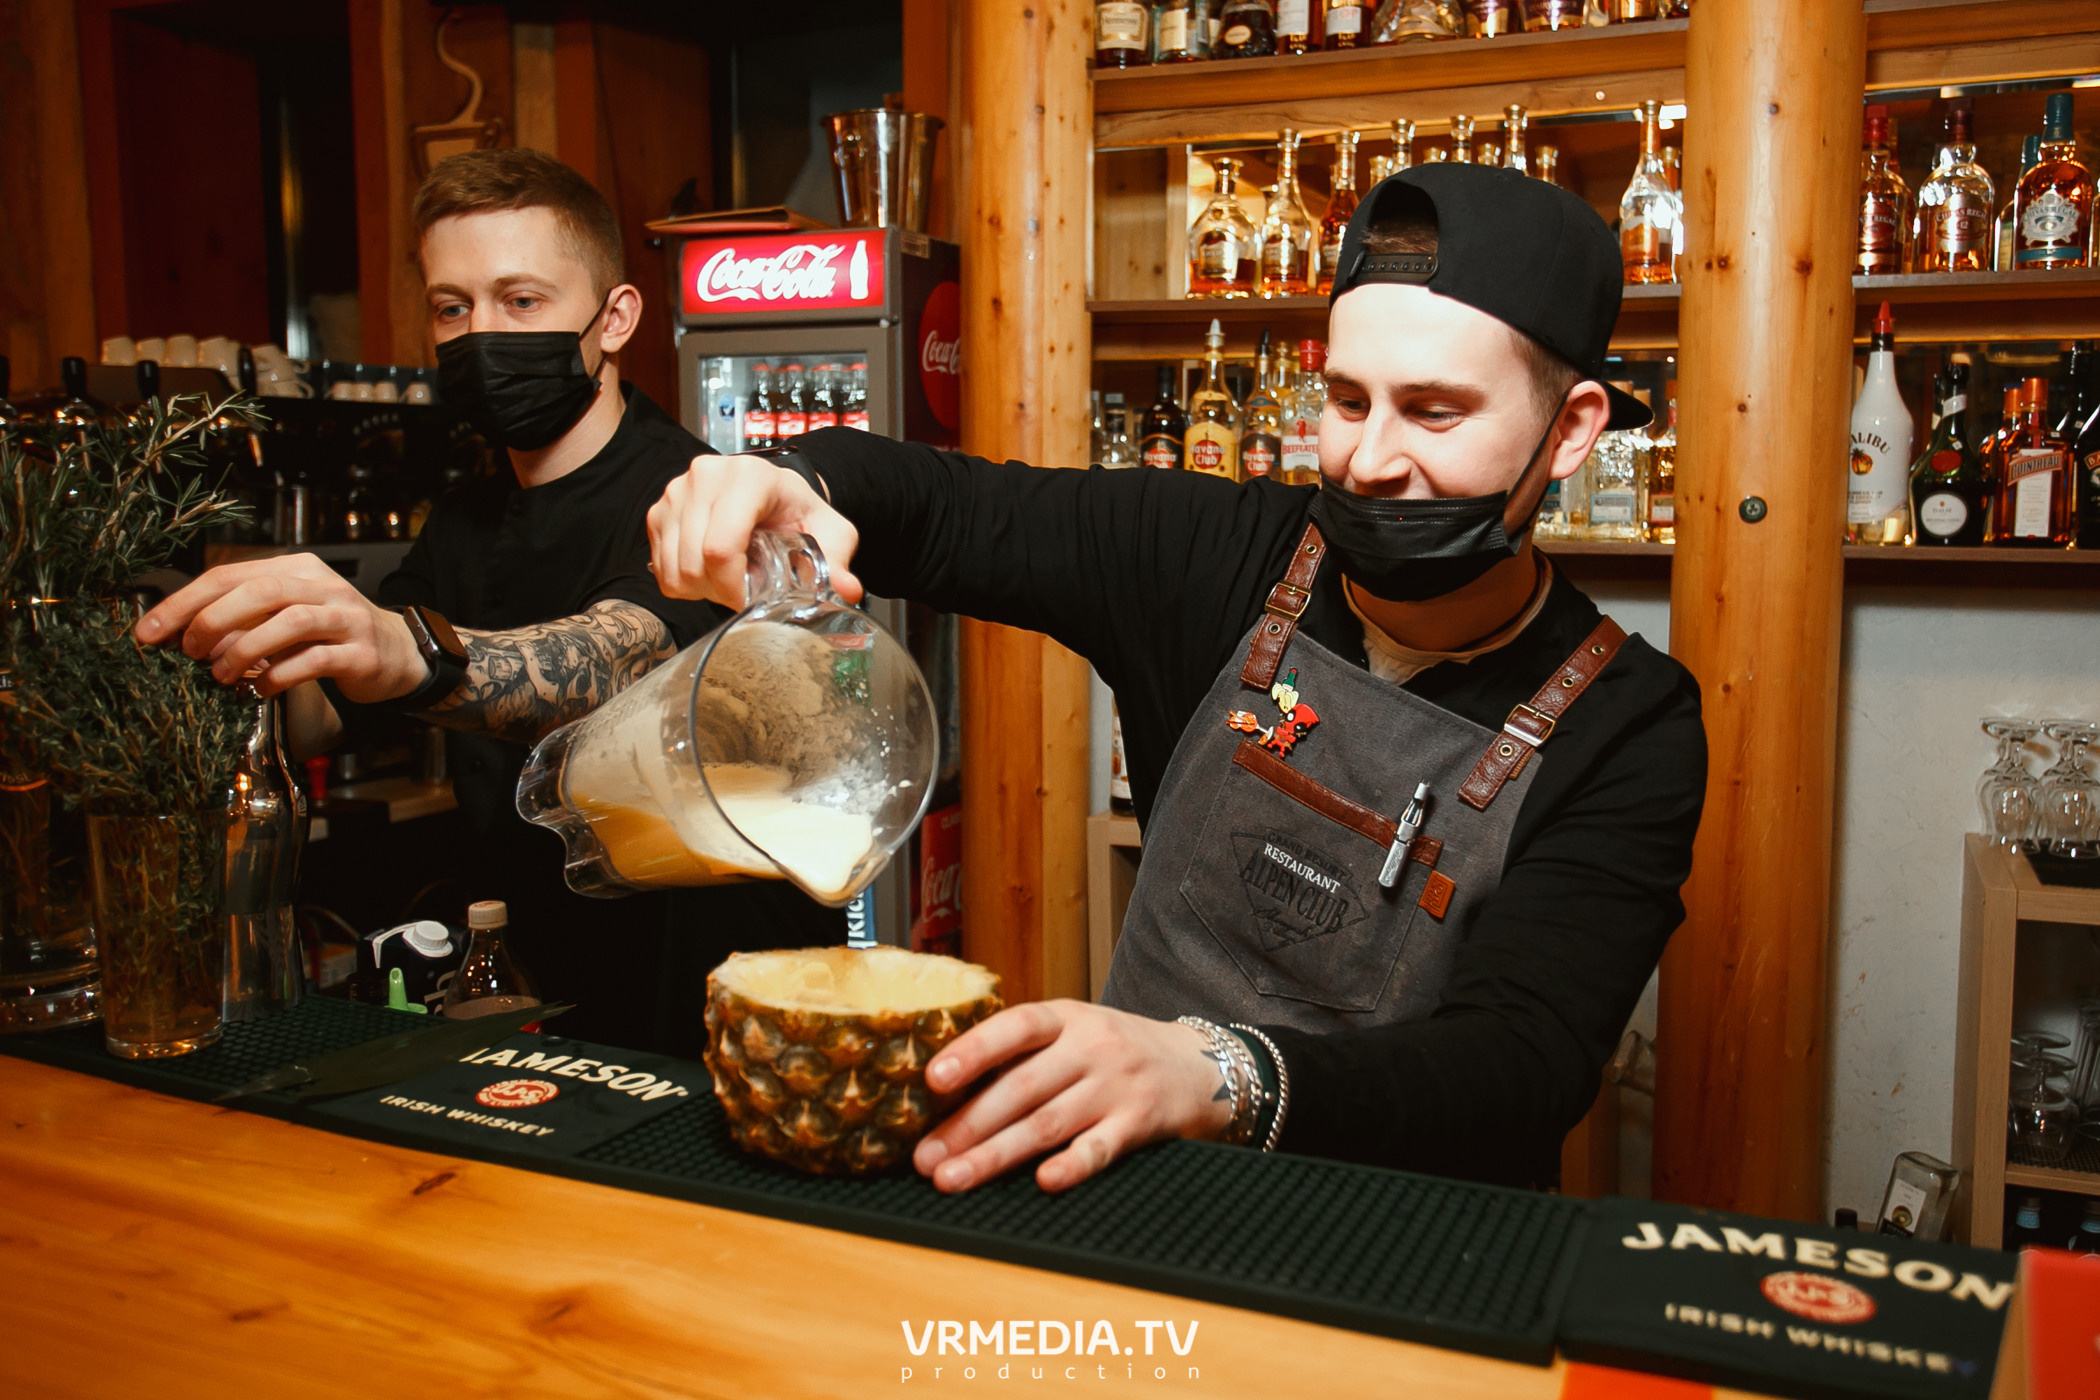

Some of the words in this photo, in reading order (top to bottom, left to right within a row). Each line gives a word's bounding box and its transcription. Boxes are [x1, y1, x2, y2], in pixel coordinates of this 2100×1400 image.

[697, 244, 846, 303] Coca-Cola
[1190, 444, 1225, 455] Havana
[1195, 454, 1218, 465] Club
[1243, 452, 1275, 462] Havana
[1247, 460, 1268, 471] Club
[2011, 455, 2060, 480] COINTREAU
[1263, 842, 1341, 894] RESTAURANT
[1240, 848, 1302, 907] ALPEN
[1297, 886, 1349, 932] CLUB
[380, 1095, 446, 1115] IRISH
[446, 1108, 555, 1137] WHISKEY
[1621, 1222, 2014, 1310] JAMESON
[1665, 1302, 1775, 1339] IRISH
